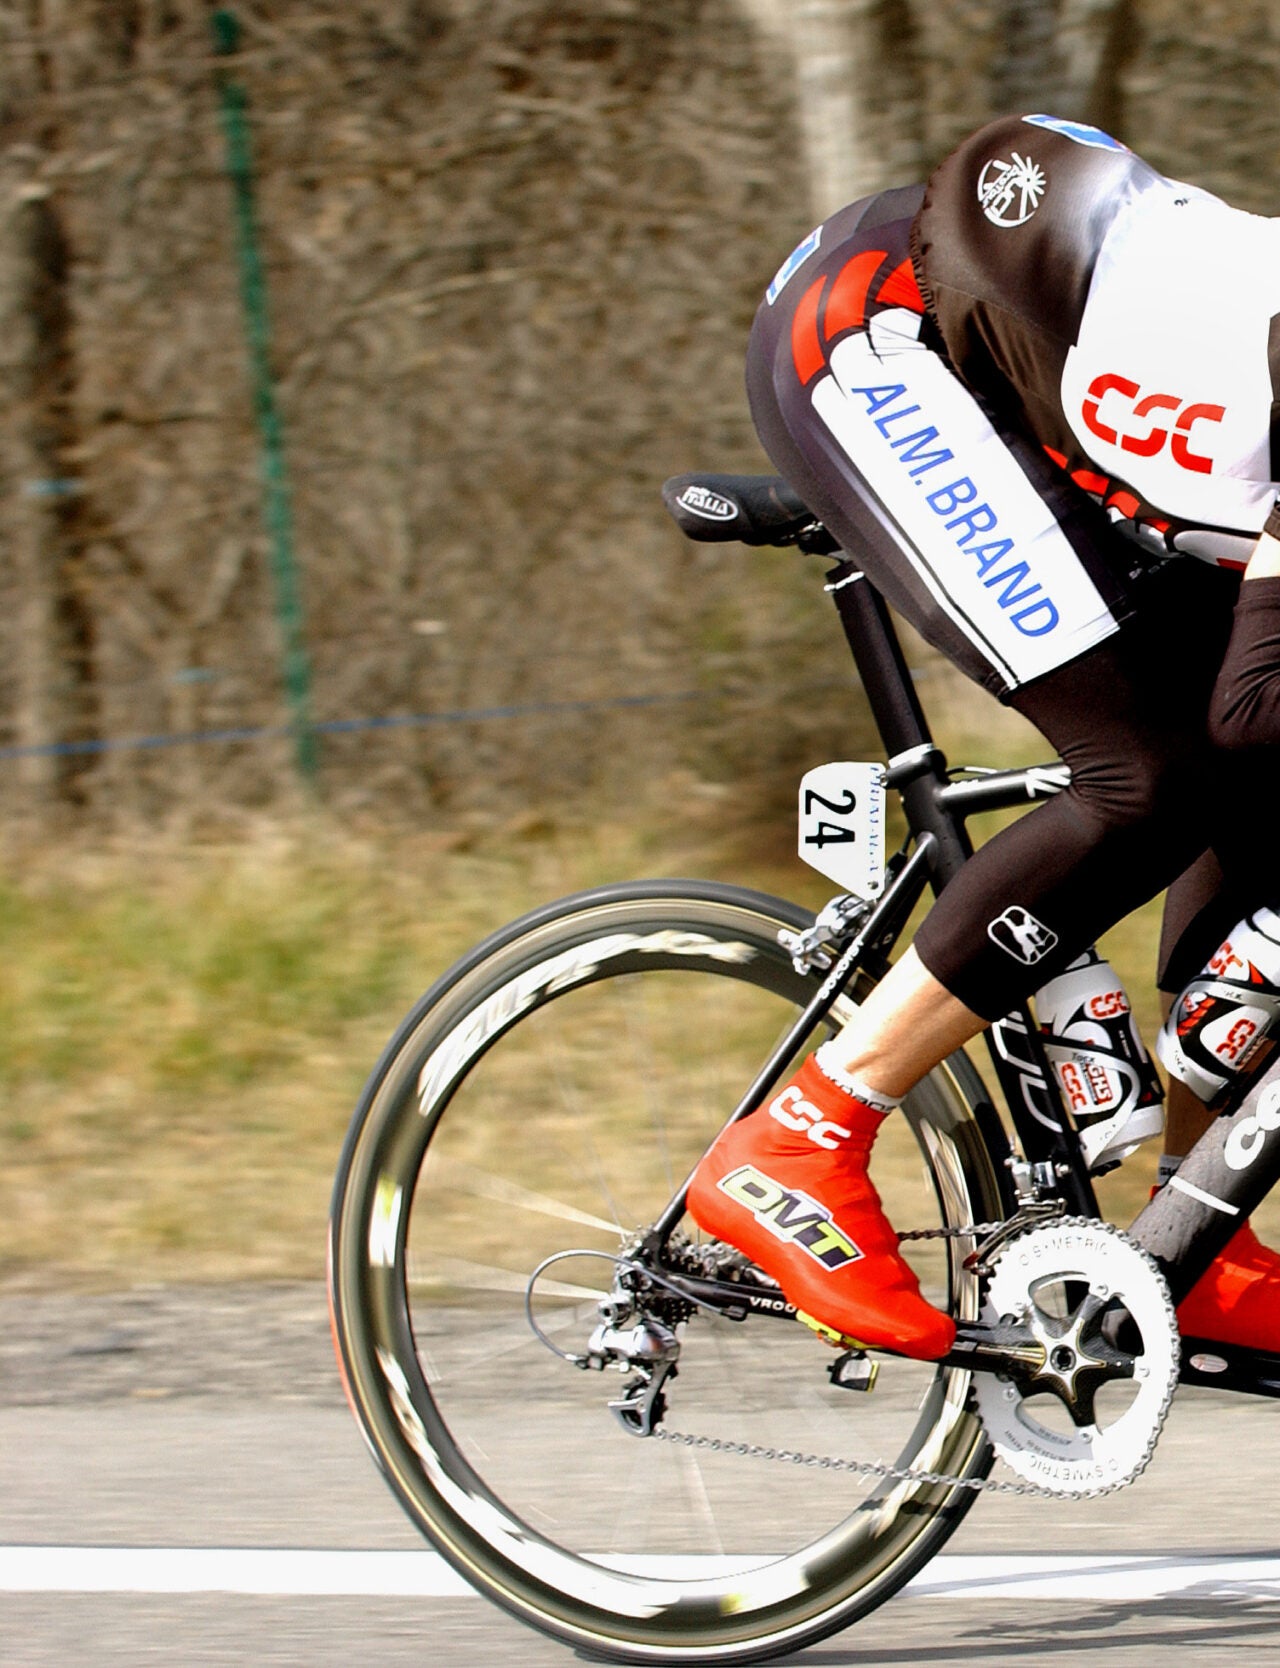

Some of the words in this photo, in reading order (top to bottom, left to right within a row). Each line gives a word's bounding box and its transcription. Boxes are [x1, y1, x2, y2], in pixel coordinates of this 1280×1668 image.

[1082, 373, 1227, 475] CSC
[925, 476, 1060, 637] BRAND
[805, 789, 856, 849] 24
[768, 1086, 851, 1150] CSC
[1060, 1062, 1088, 1111] CSC
[720, 1167, 864, 1270] DVT
